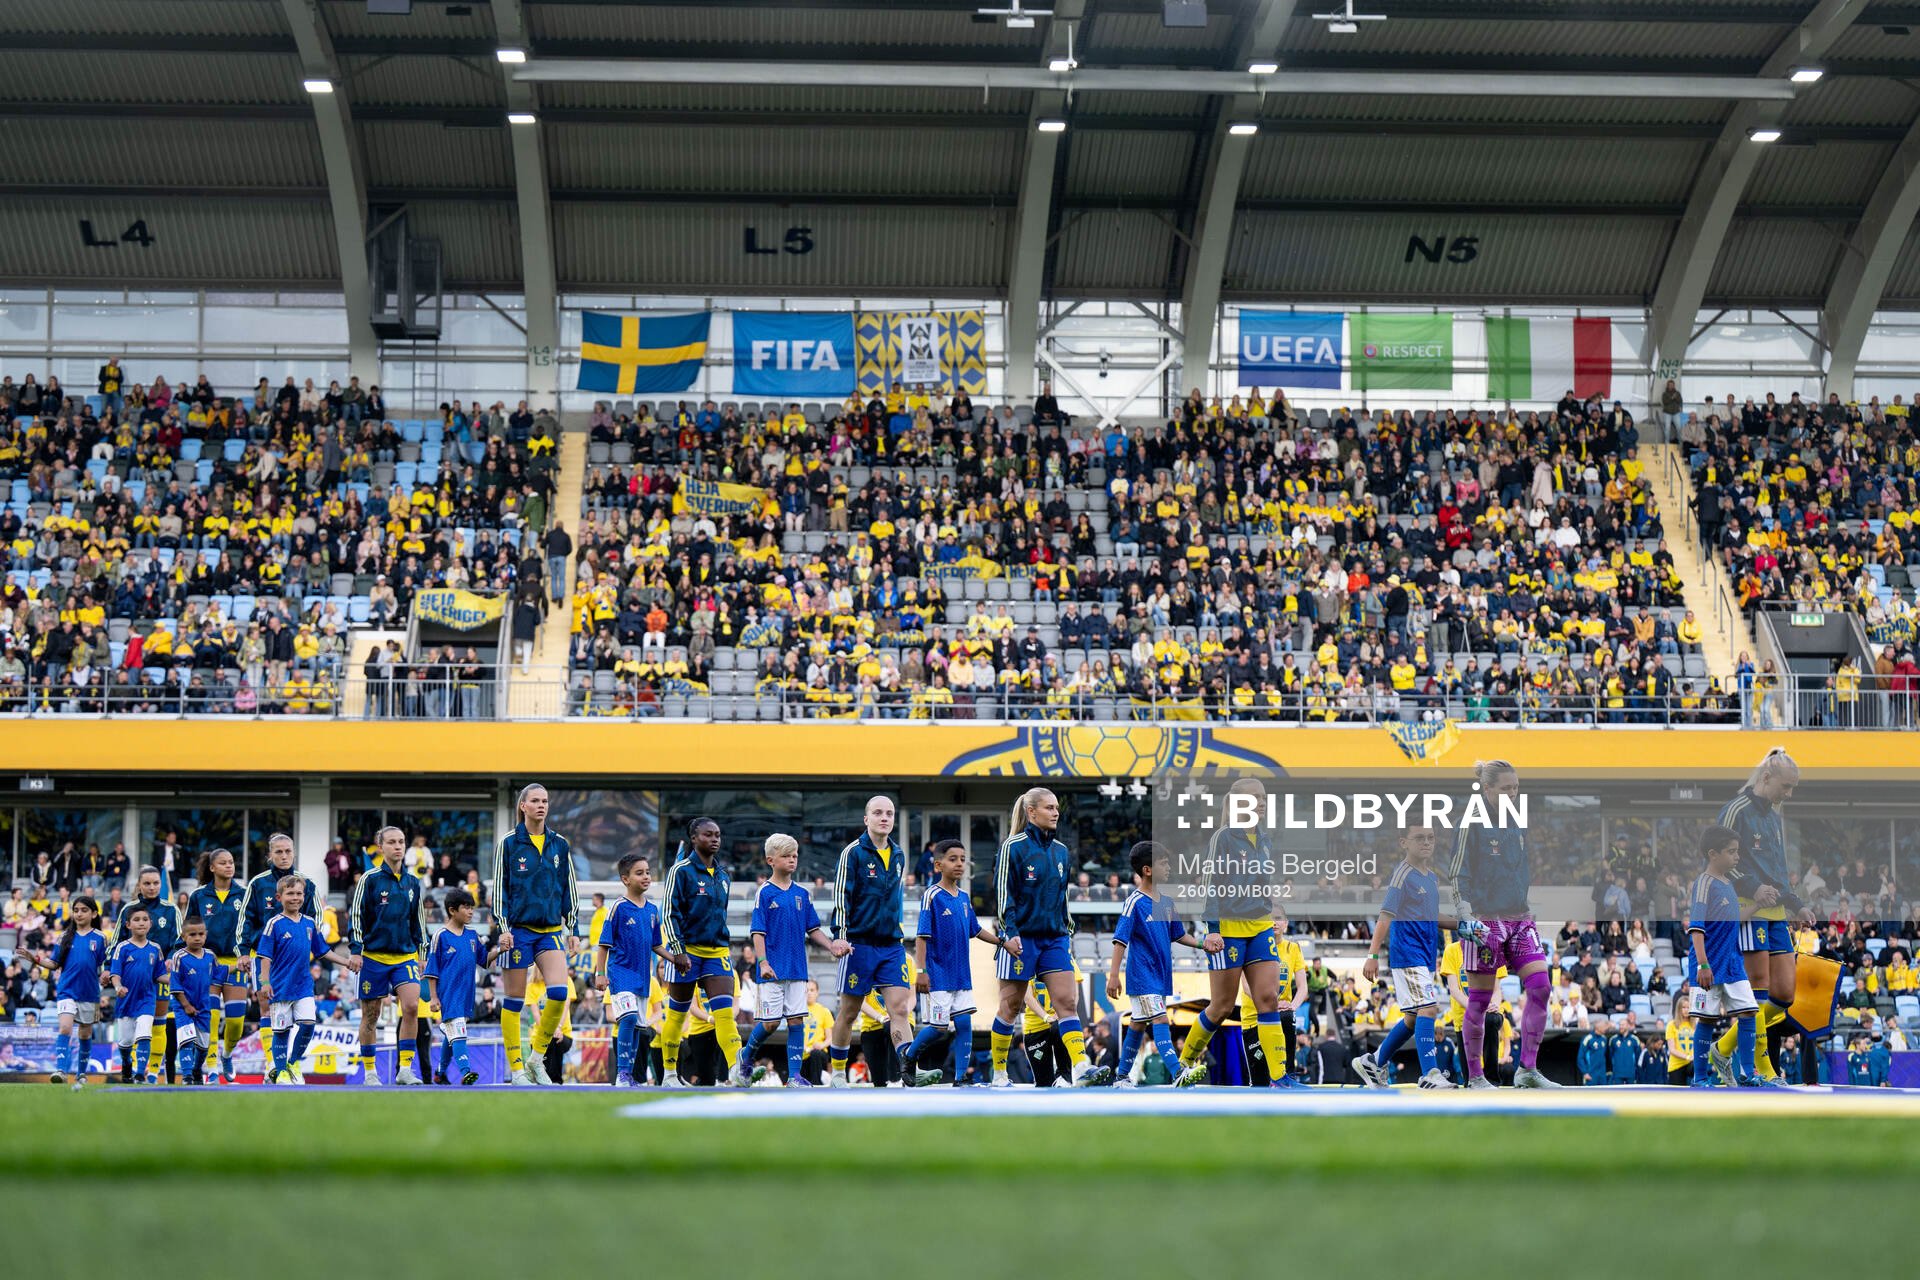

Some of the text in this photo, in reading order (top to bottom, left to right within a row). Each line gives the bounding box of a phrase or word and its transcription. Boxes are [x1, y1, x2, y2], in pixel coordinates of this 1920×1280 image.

[79, 219, 156, 247] L4
[744, 227, 814, 255] L5
[1404, 236, 1479, 264] N5
[535, 356, 550, 366] L5
[751, 340, 841, 371] FIFA
[1243, 335, 1338, 365] UEFA
[1382, 344, 1444, 358] RESPECT
[686, 478, 721, 496] HEJA
[30, 780, 44, 790] K3
